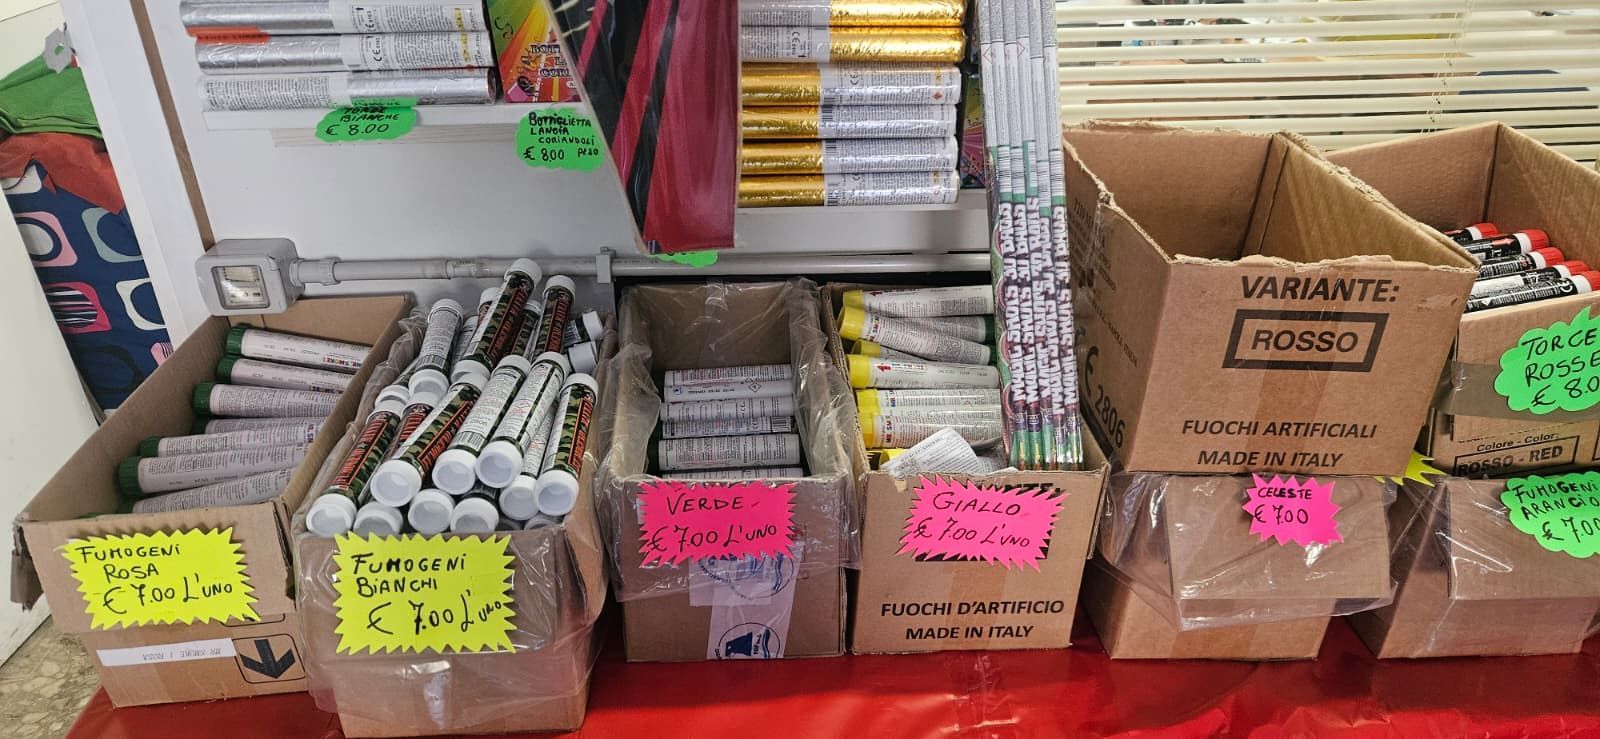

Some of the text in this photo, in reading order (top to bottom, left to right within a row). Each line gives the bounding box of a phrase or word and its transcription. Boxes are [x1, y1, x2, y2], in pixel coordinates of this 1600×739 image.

[325, 123, 389, 136] € 8.00
[523, 146, 536, 161] €
[541, 147, 565, 163] 8.00
[1241, 275, 1400, 303] VARIANTE:
[1252, 329, 1358, 352] ROSSO
[1521, 328, 1598, 361] TORCE
[1525, 350, 1600, 388] ROSSE
[1531, 385, 1556, 408] €
[1098, 383, 1127, 449] 2806
[1182, 420, 1378, 439] FUOCHI ARTIFICIALI
[1476, 440, 1514, 452] Colore
[1524, 432, 1559, 444] Color:
[1197, 450, 1343, 468] MADE IN ITALY
[1457, 454, 1514, 476] ROSSO
[1529, 445, 1564, 462] RED
[933, 491, 1021, 516] GIALLO
[1258, 487, 1312, 500] CELESTE
[1511, 480, 1598, 504] FUMOGENI
[666, 493, 743, 516] VERDE
[1254, 504, 1308, 525] € 7.00
[1521, 494, 1600, 520] ARANCIO
[648, 524, 777, 552] € 7.00 L'UNO
[913, 516, 1030, 548] € 7.00 L'UNO
[1542, 521, 1565, 540] €
[75, 544, 180, 563] FUMOGENI
[351, 552, 466, 574] FUMOGENI
[103, 563, 159, 583] ROSA
[102, 573, 233, 614] € 7.00 L'UNO
[356, 576, 437, 597] BIANCHI
[366, 589, 502, 635] € 7.00 L'UNO
[881, 600, 1064, 617] FUOCHI D'ARTIFICIO
[905, 625, 1034, 640] MADE IN ITALY
